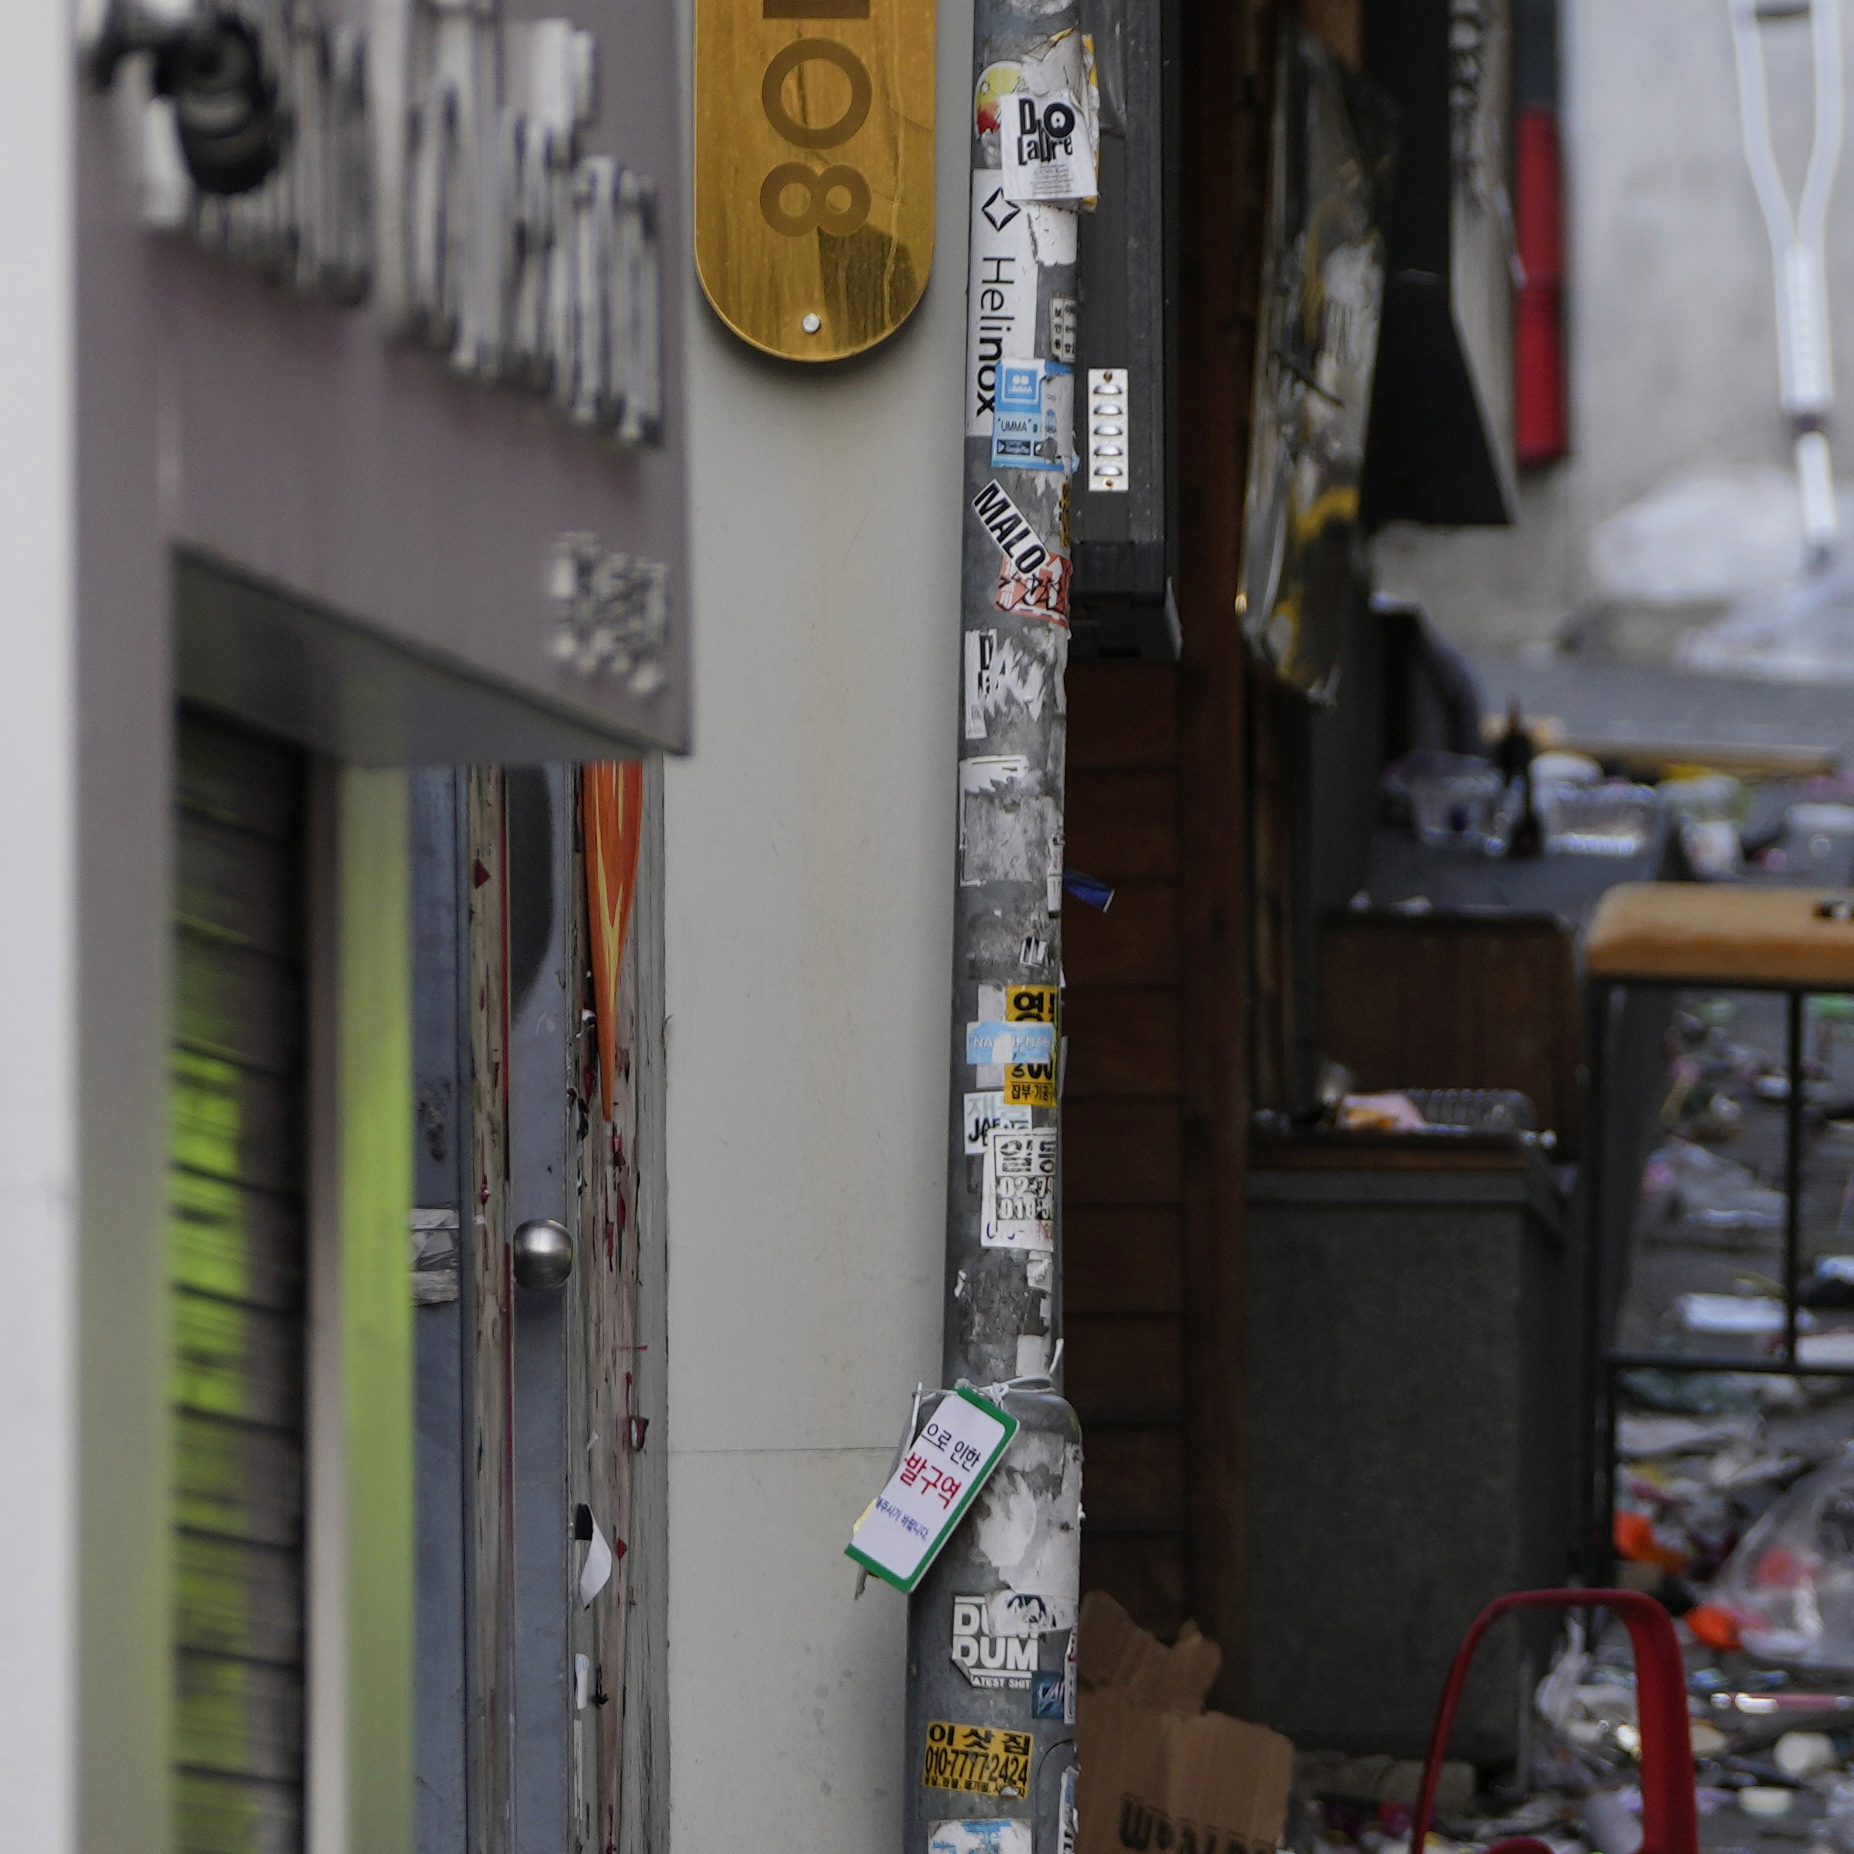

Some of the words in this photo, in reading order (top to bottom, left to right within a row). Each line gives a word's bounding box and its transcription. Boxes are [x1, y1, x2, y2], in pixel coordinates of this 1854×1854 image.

[976, 256, 1016, 417] Helinox
[973, 482, 1046, 574] MALO
[900, 1451, 962, 1510] 발구역
[952, 1635, 1039, 1671] DUM
[925, 1745, 1029, 1787] 010-7777-2424
